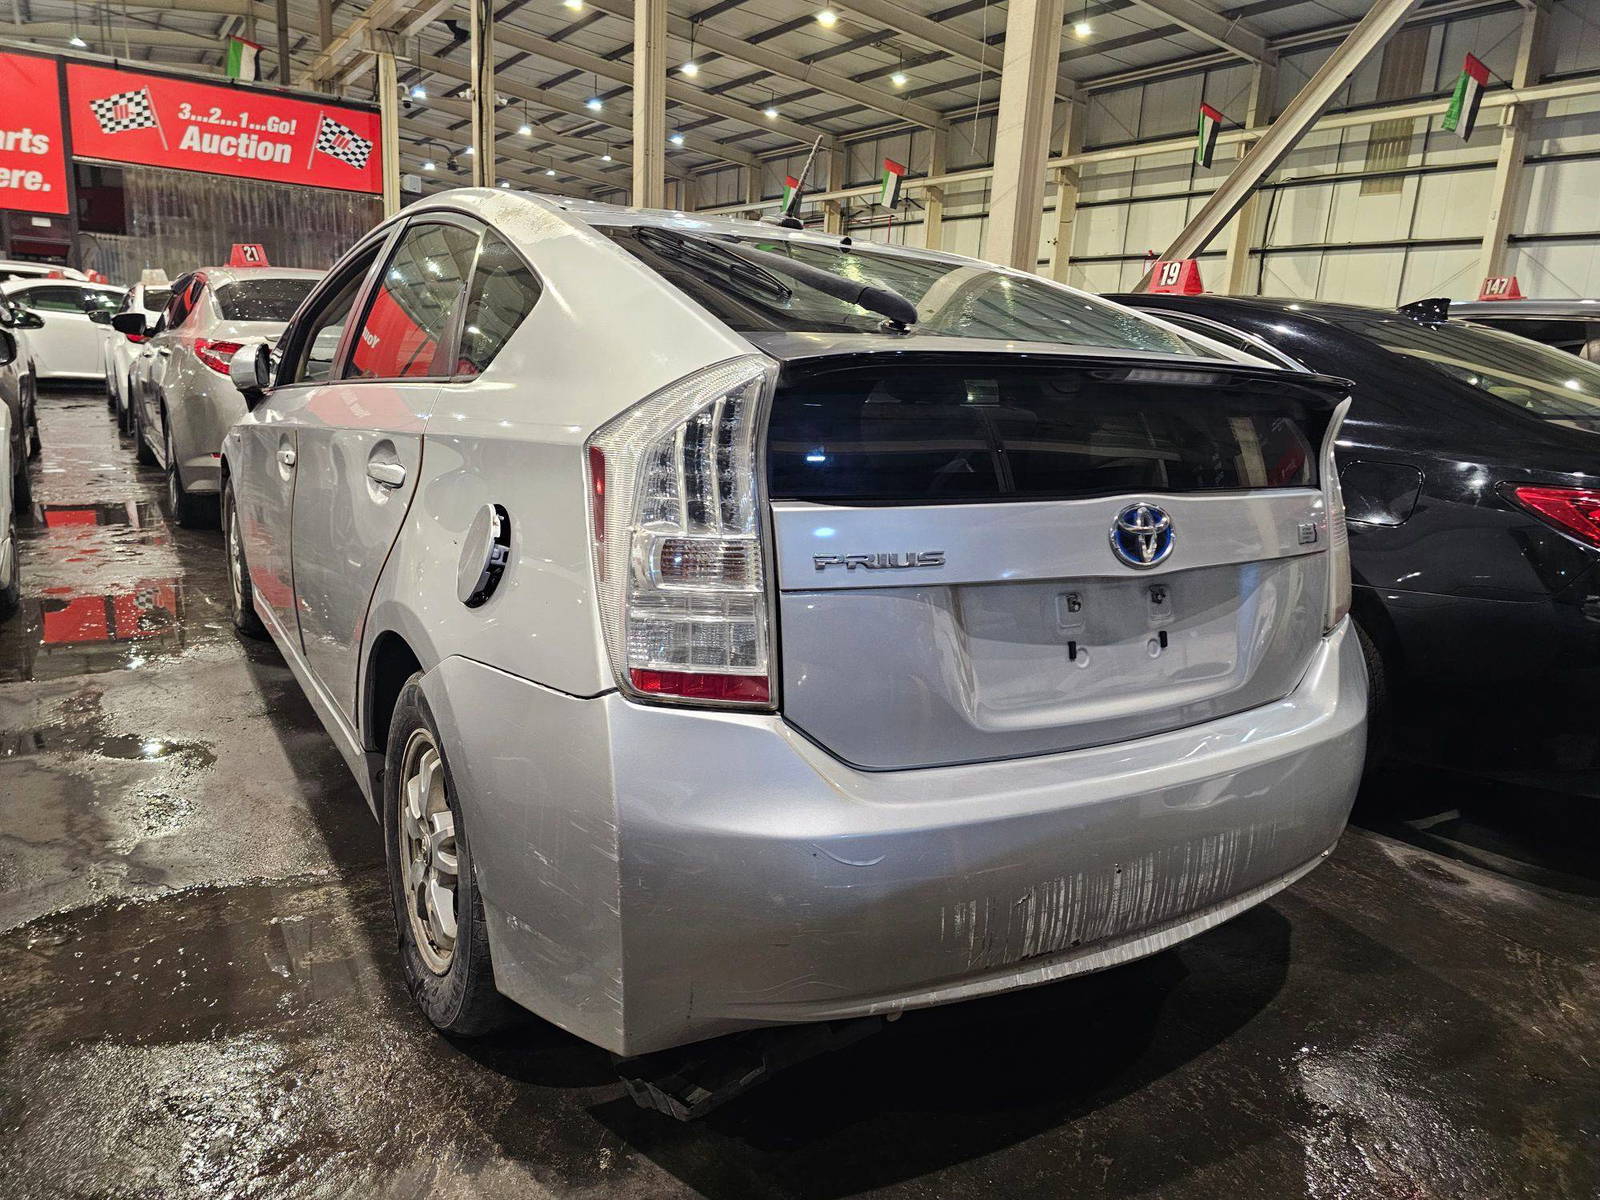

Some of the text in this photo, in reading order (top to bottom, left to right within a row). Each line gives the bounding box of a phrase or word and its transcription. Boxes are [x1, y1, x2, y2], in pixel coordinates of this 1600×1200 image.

[179, 125, 292, 164] Auction
[243, 246, 260, 261] 21
[1160, 262, 1181, 286] 19
[1485, 278, 1508, 295] 147
[812, 551, 946, 570] PRIUS
